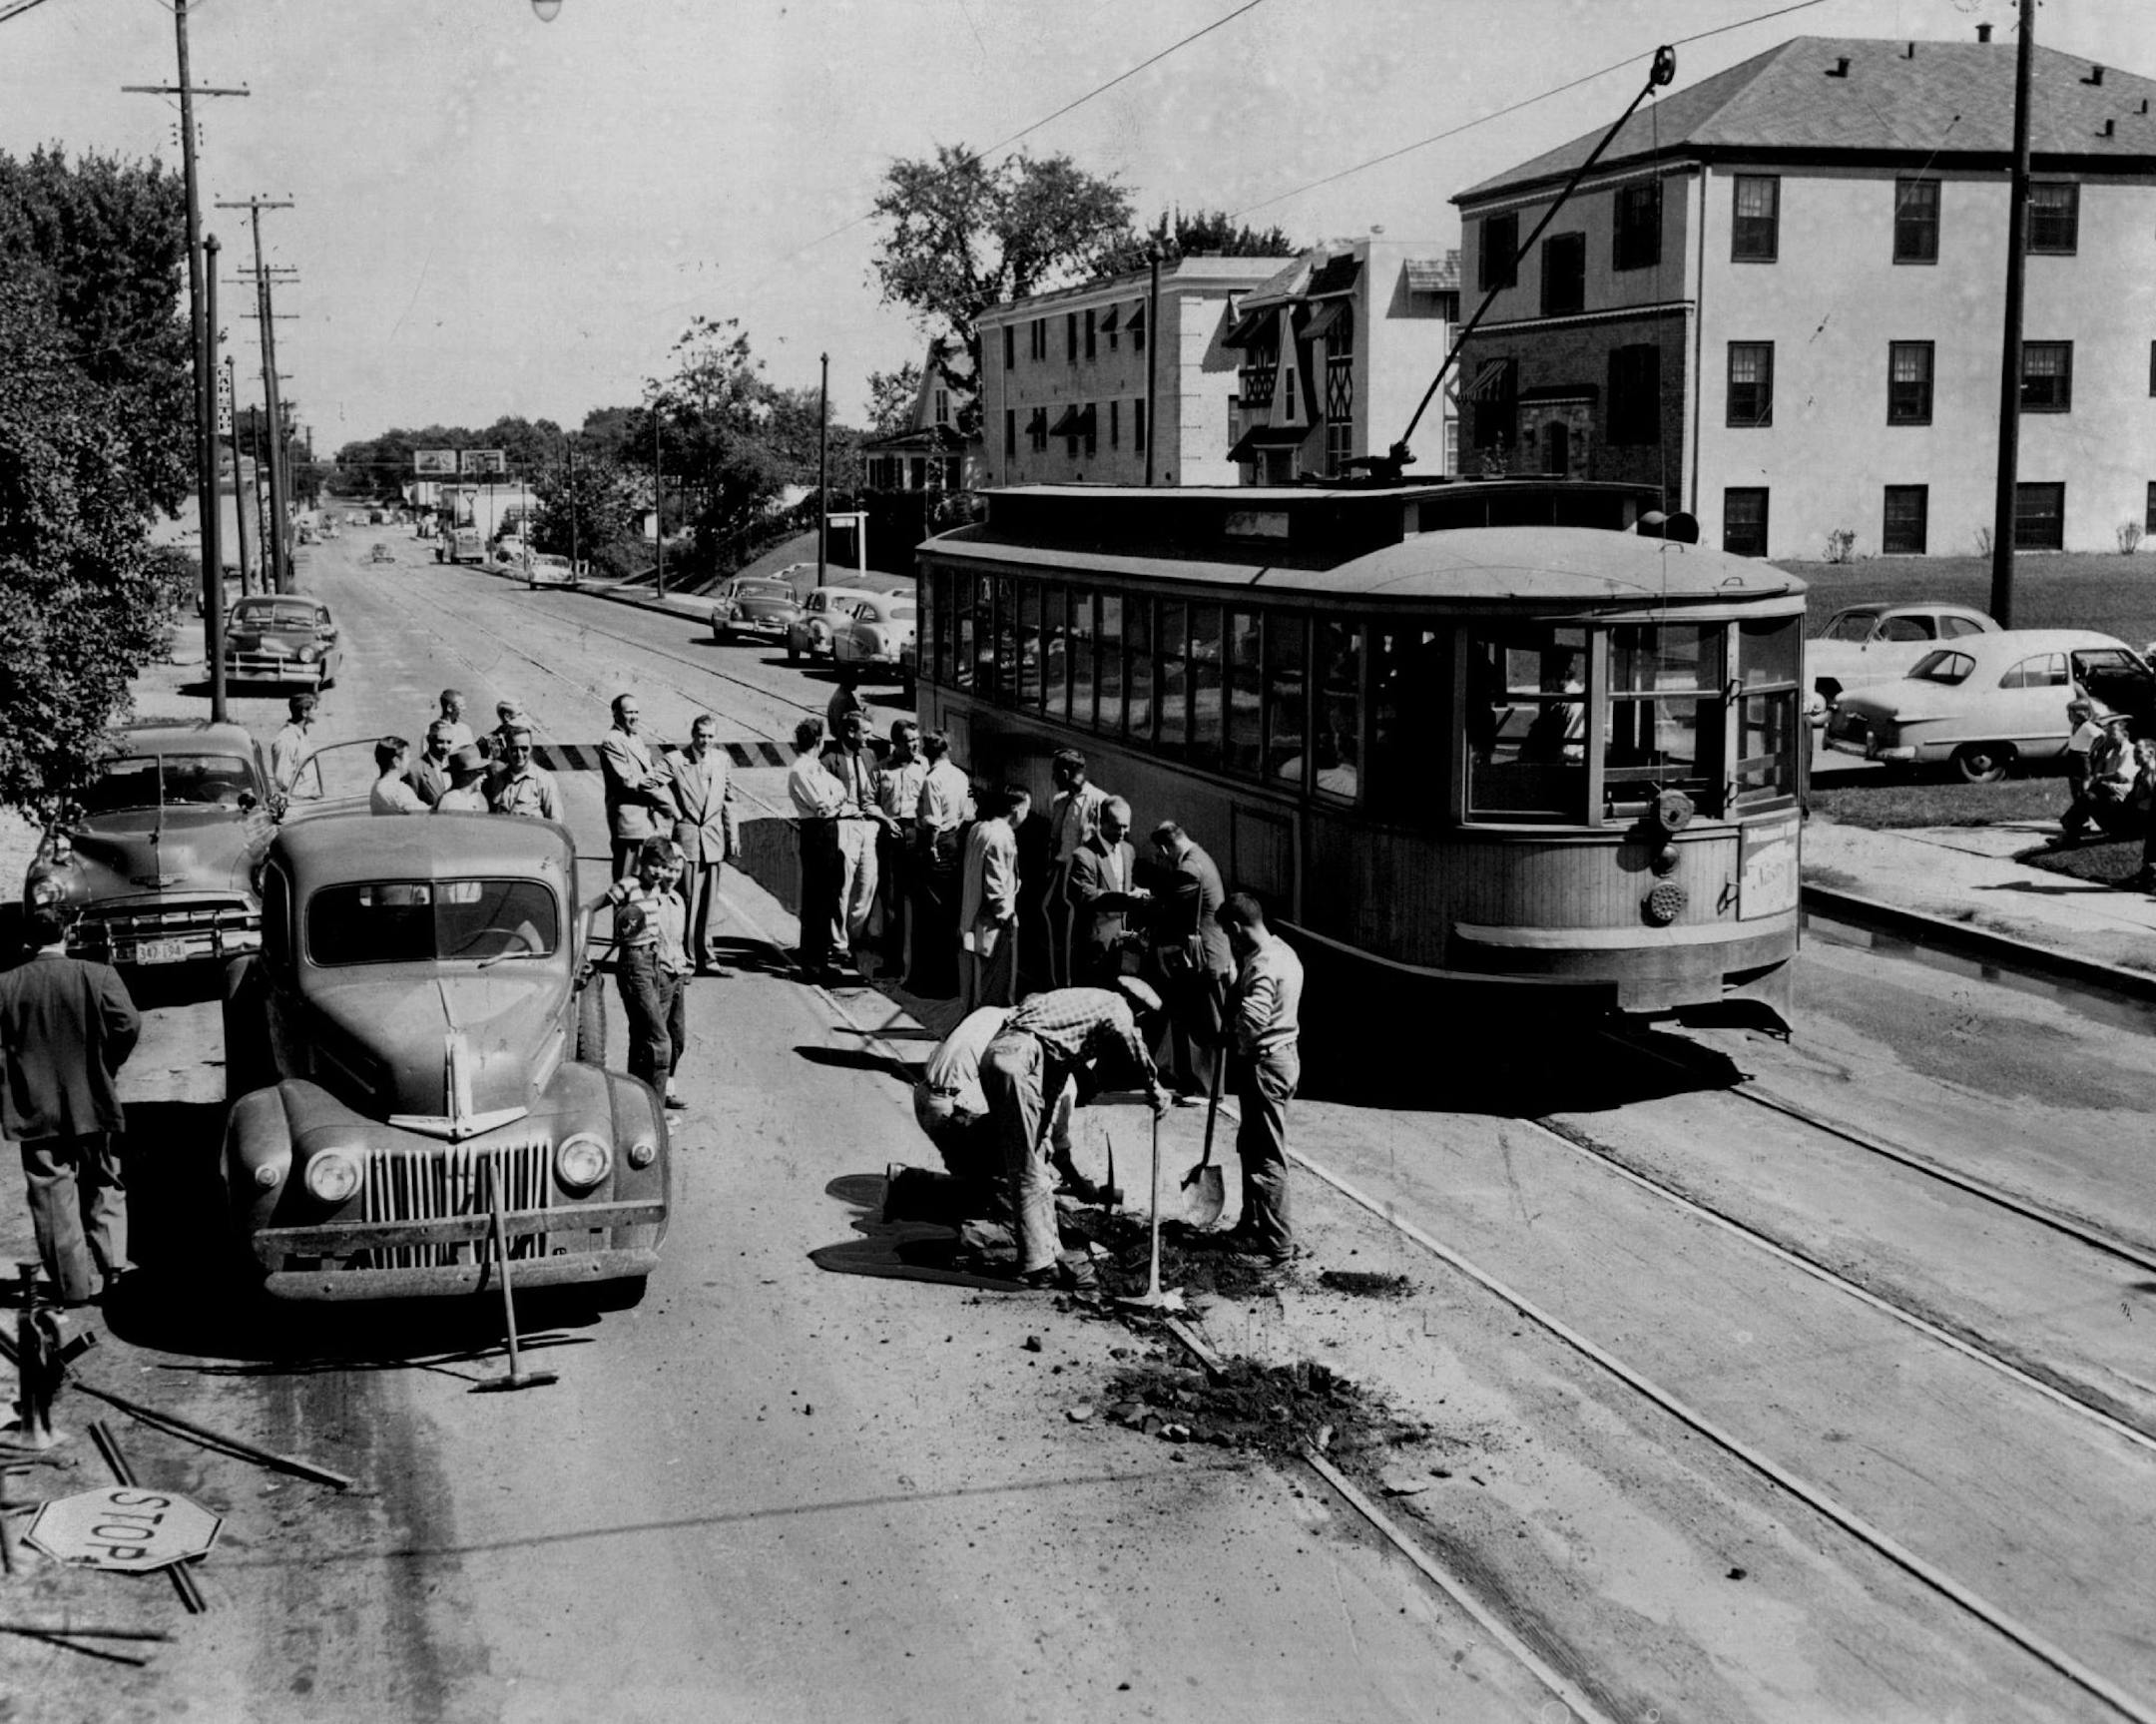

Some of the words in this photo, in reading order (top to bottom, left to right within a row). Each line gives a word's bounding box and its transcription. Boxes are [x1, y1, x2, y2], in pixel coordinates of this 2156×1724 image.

[218, 368, 230, 393] CAR
[219, 397, 232, 430] STOP
[85, 1490, 171, 1560] STOP
